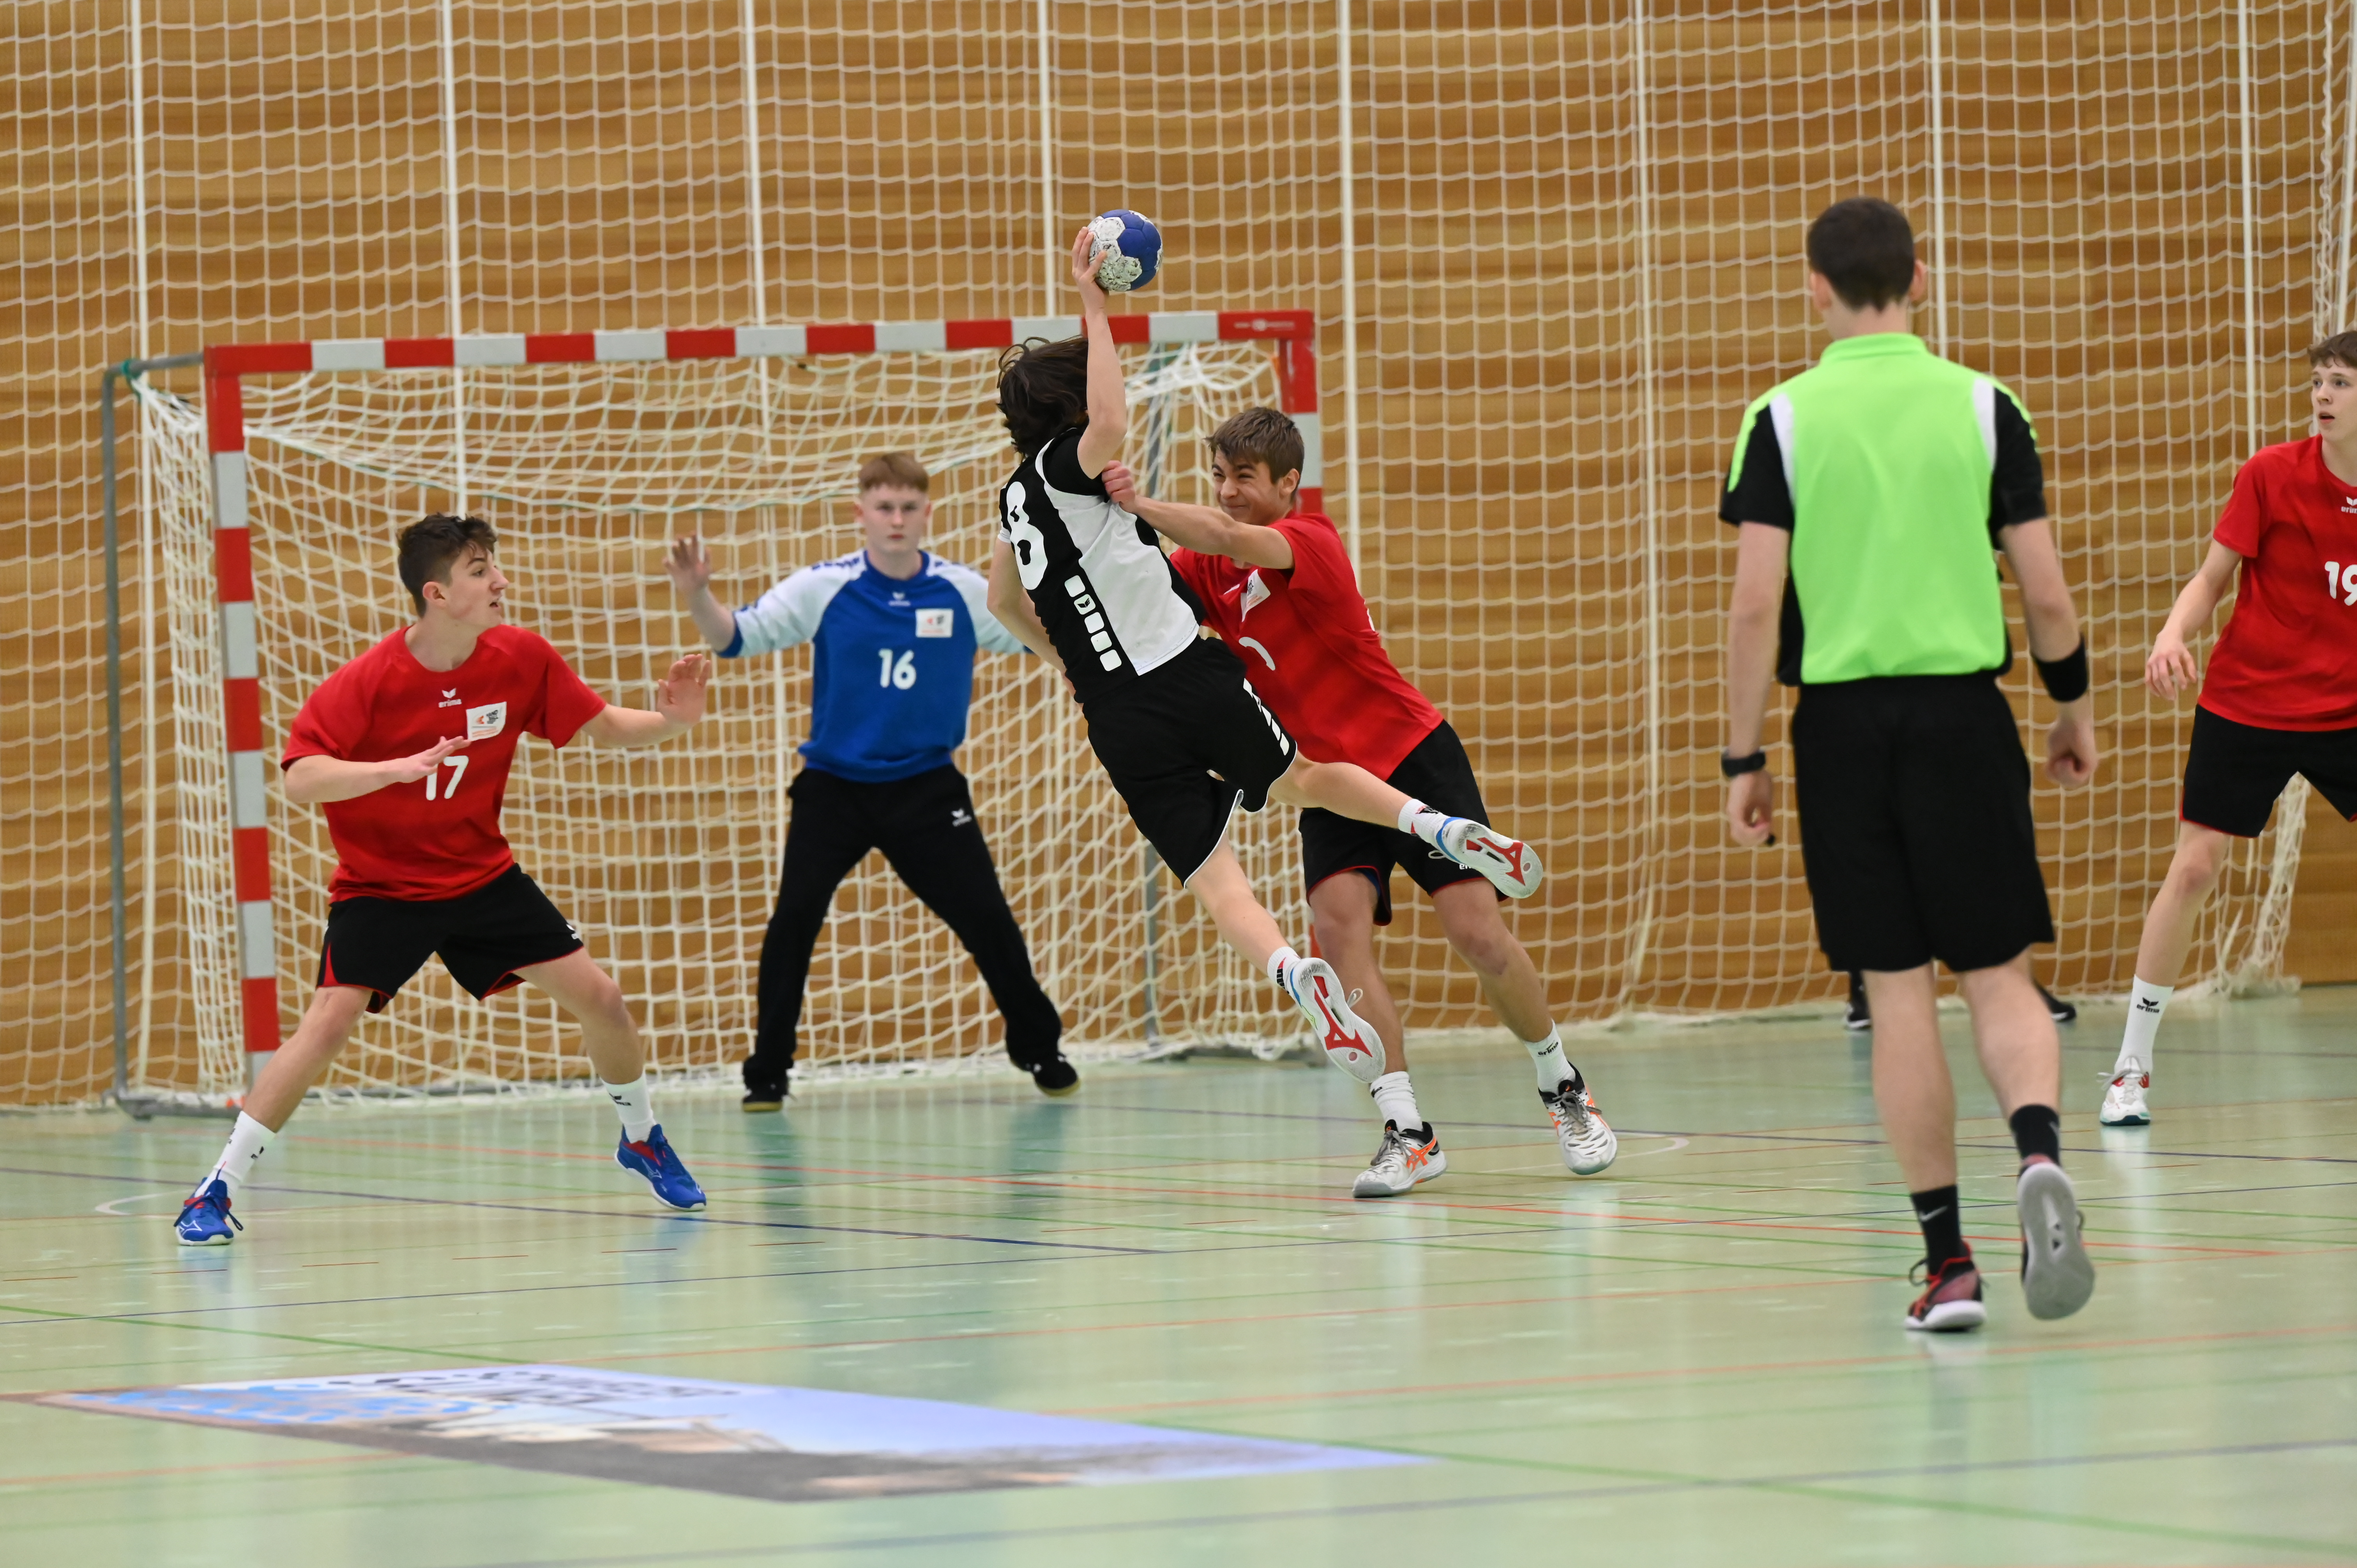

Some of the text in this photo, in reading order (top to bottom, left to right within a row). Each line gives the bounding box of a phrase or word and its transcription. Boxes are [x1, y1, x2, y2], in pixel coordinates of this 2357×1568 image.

[1006, 482, 1048, 590] 8
[2325, 561, 2357, 606] 19
[878, 648, 916, 690] 16
[426, 755, 469, 800] 17
[2136, 1004, 2160, 1013] erima
